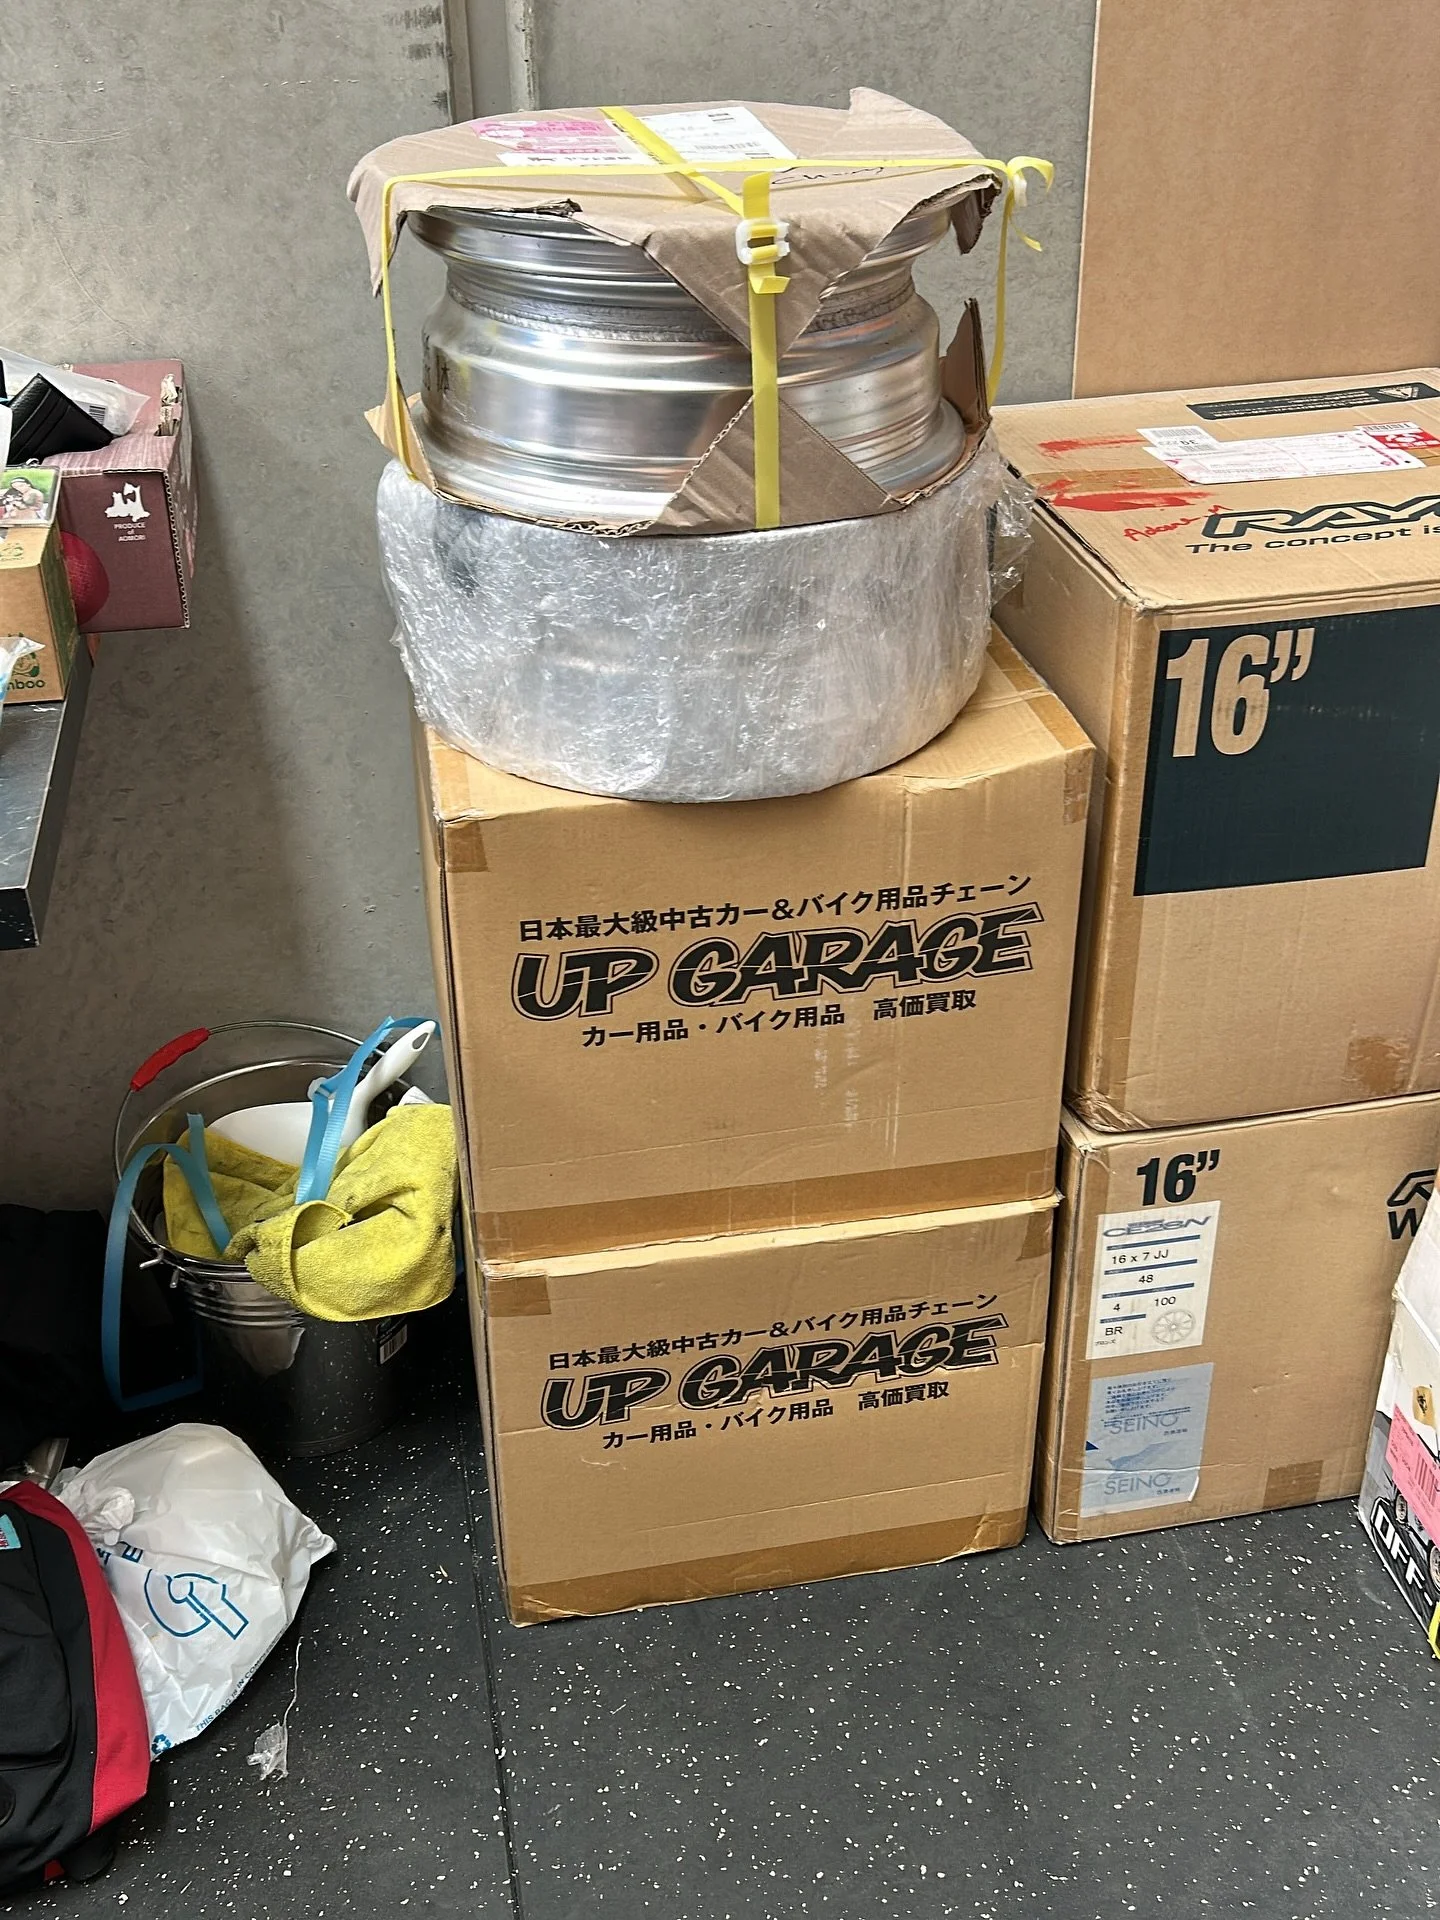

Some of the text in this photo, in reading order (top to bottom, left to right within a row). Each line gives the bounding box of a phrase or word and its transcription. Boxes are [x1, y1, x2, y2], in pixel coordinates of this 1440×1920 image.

[113, 522, 146, 530] PRODUCE
[1201, 494, 1440, 539] RAY
[1185, 543, 1253, 554] The
[1264, 528, 1412, 550] concept
[511, 901, 1043, 1021] UP GARAGE
[581, 989, 977, 1047] カー用品・バイク用品 高価買取
[1111, 1255, 1126, 1265] 16
[1142, 1252, 1150, 1261] 7
[1153, 1249, 1169, 1260] JJ
[1138, 1274, 1154, 1284] 48
[1113, 1296, 1176, 1312] 4 100
[1105, 1326, 1123, 1336] BR
[541, 1367, 671, 1431] UP
[678, 1313, 1009, 1410] GARAGE
[602, 1381, 950, 1450] カー用品・バイク用品 高価買取
[1110, 1414, 1180, 1435] SEINO
[1103, 1472, 1173, 1495] SEINO
[195, 1714, 214, 1732] THIS
[236, 1679, 245, 1690] IN
